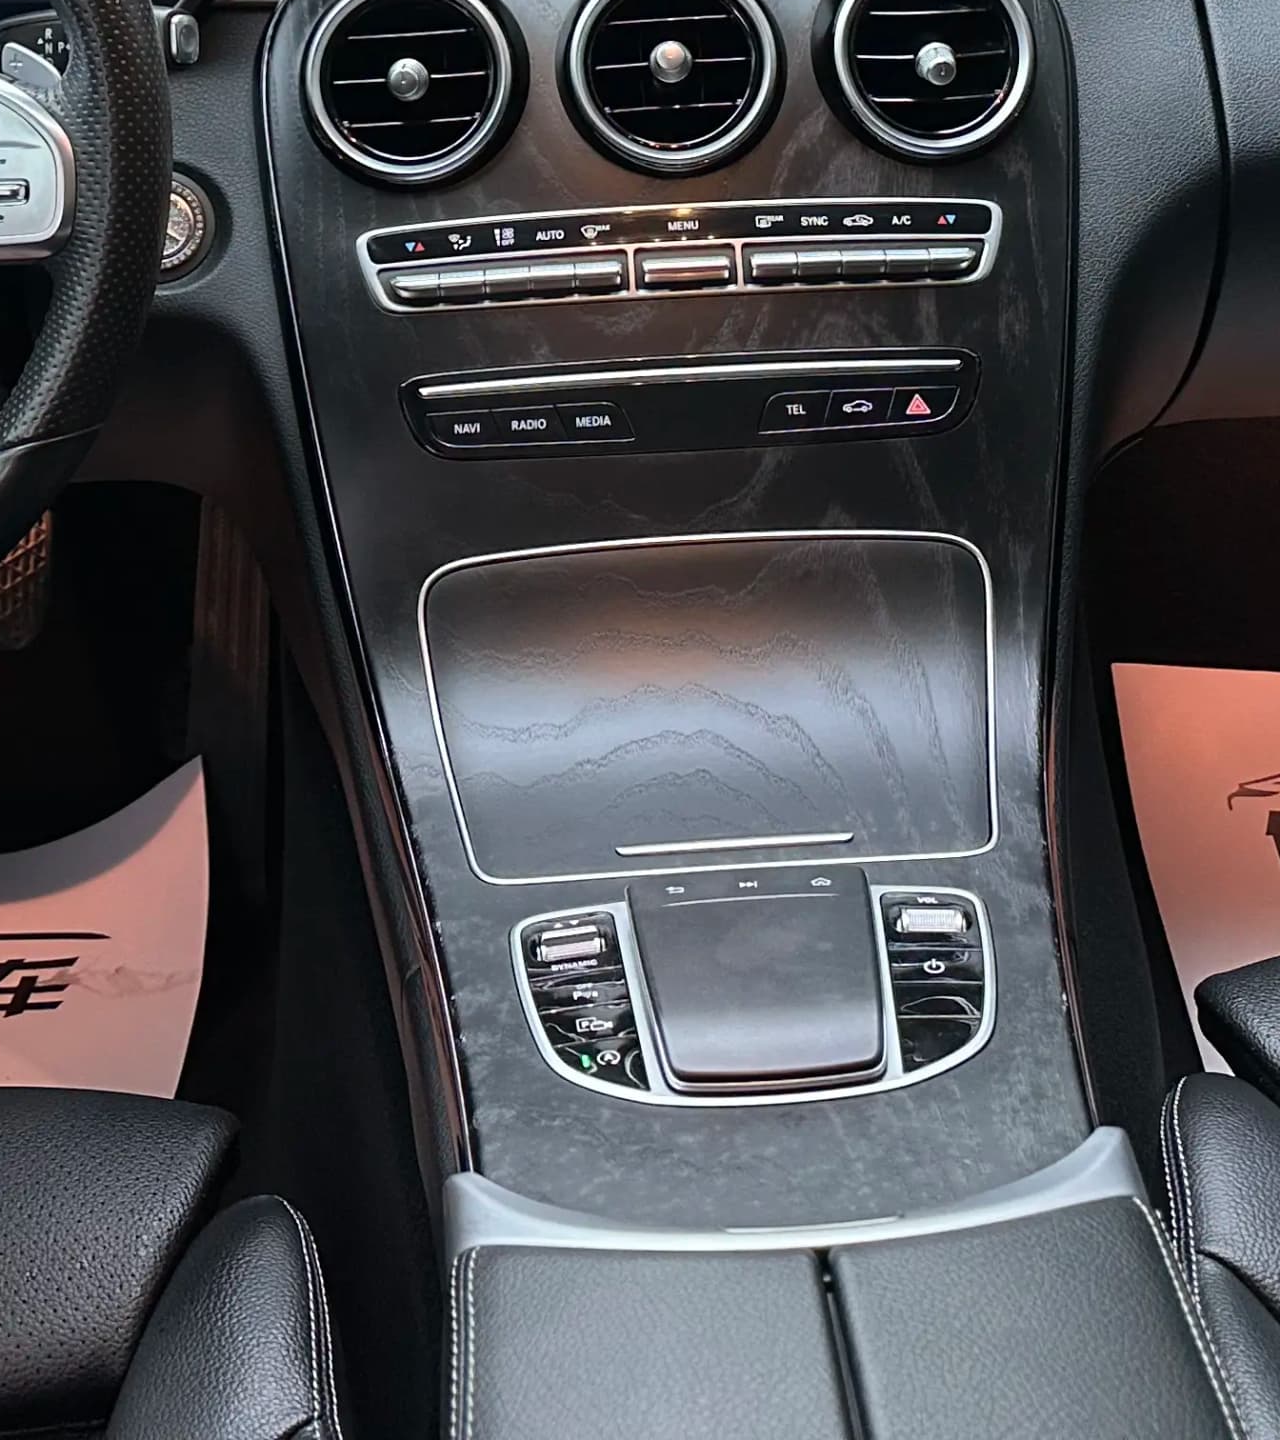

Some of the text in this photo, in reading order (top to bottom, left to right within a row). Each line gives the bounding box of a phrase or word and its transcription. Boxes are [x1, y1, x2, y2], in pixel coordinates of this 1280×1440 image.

[45, 28, 52, 40] R
[45, 42, 53, 54] N
[58, 41, 65, 53] P
[668, 219, 699, 233] MENU
[801, 216, 829, 227] SYNC
[892, 215, 911, 225] A/C
[536, 229, 565, 241] AUTO
[786, 403, 806, 416] TEL
[511, 417, 547, 432] RADIO
[575, 414, 611, 429] MEDIA
[454, 422, 481, 436] NAVI
